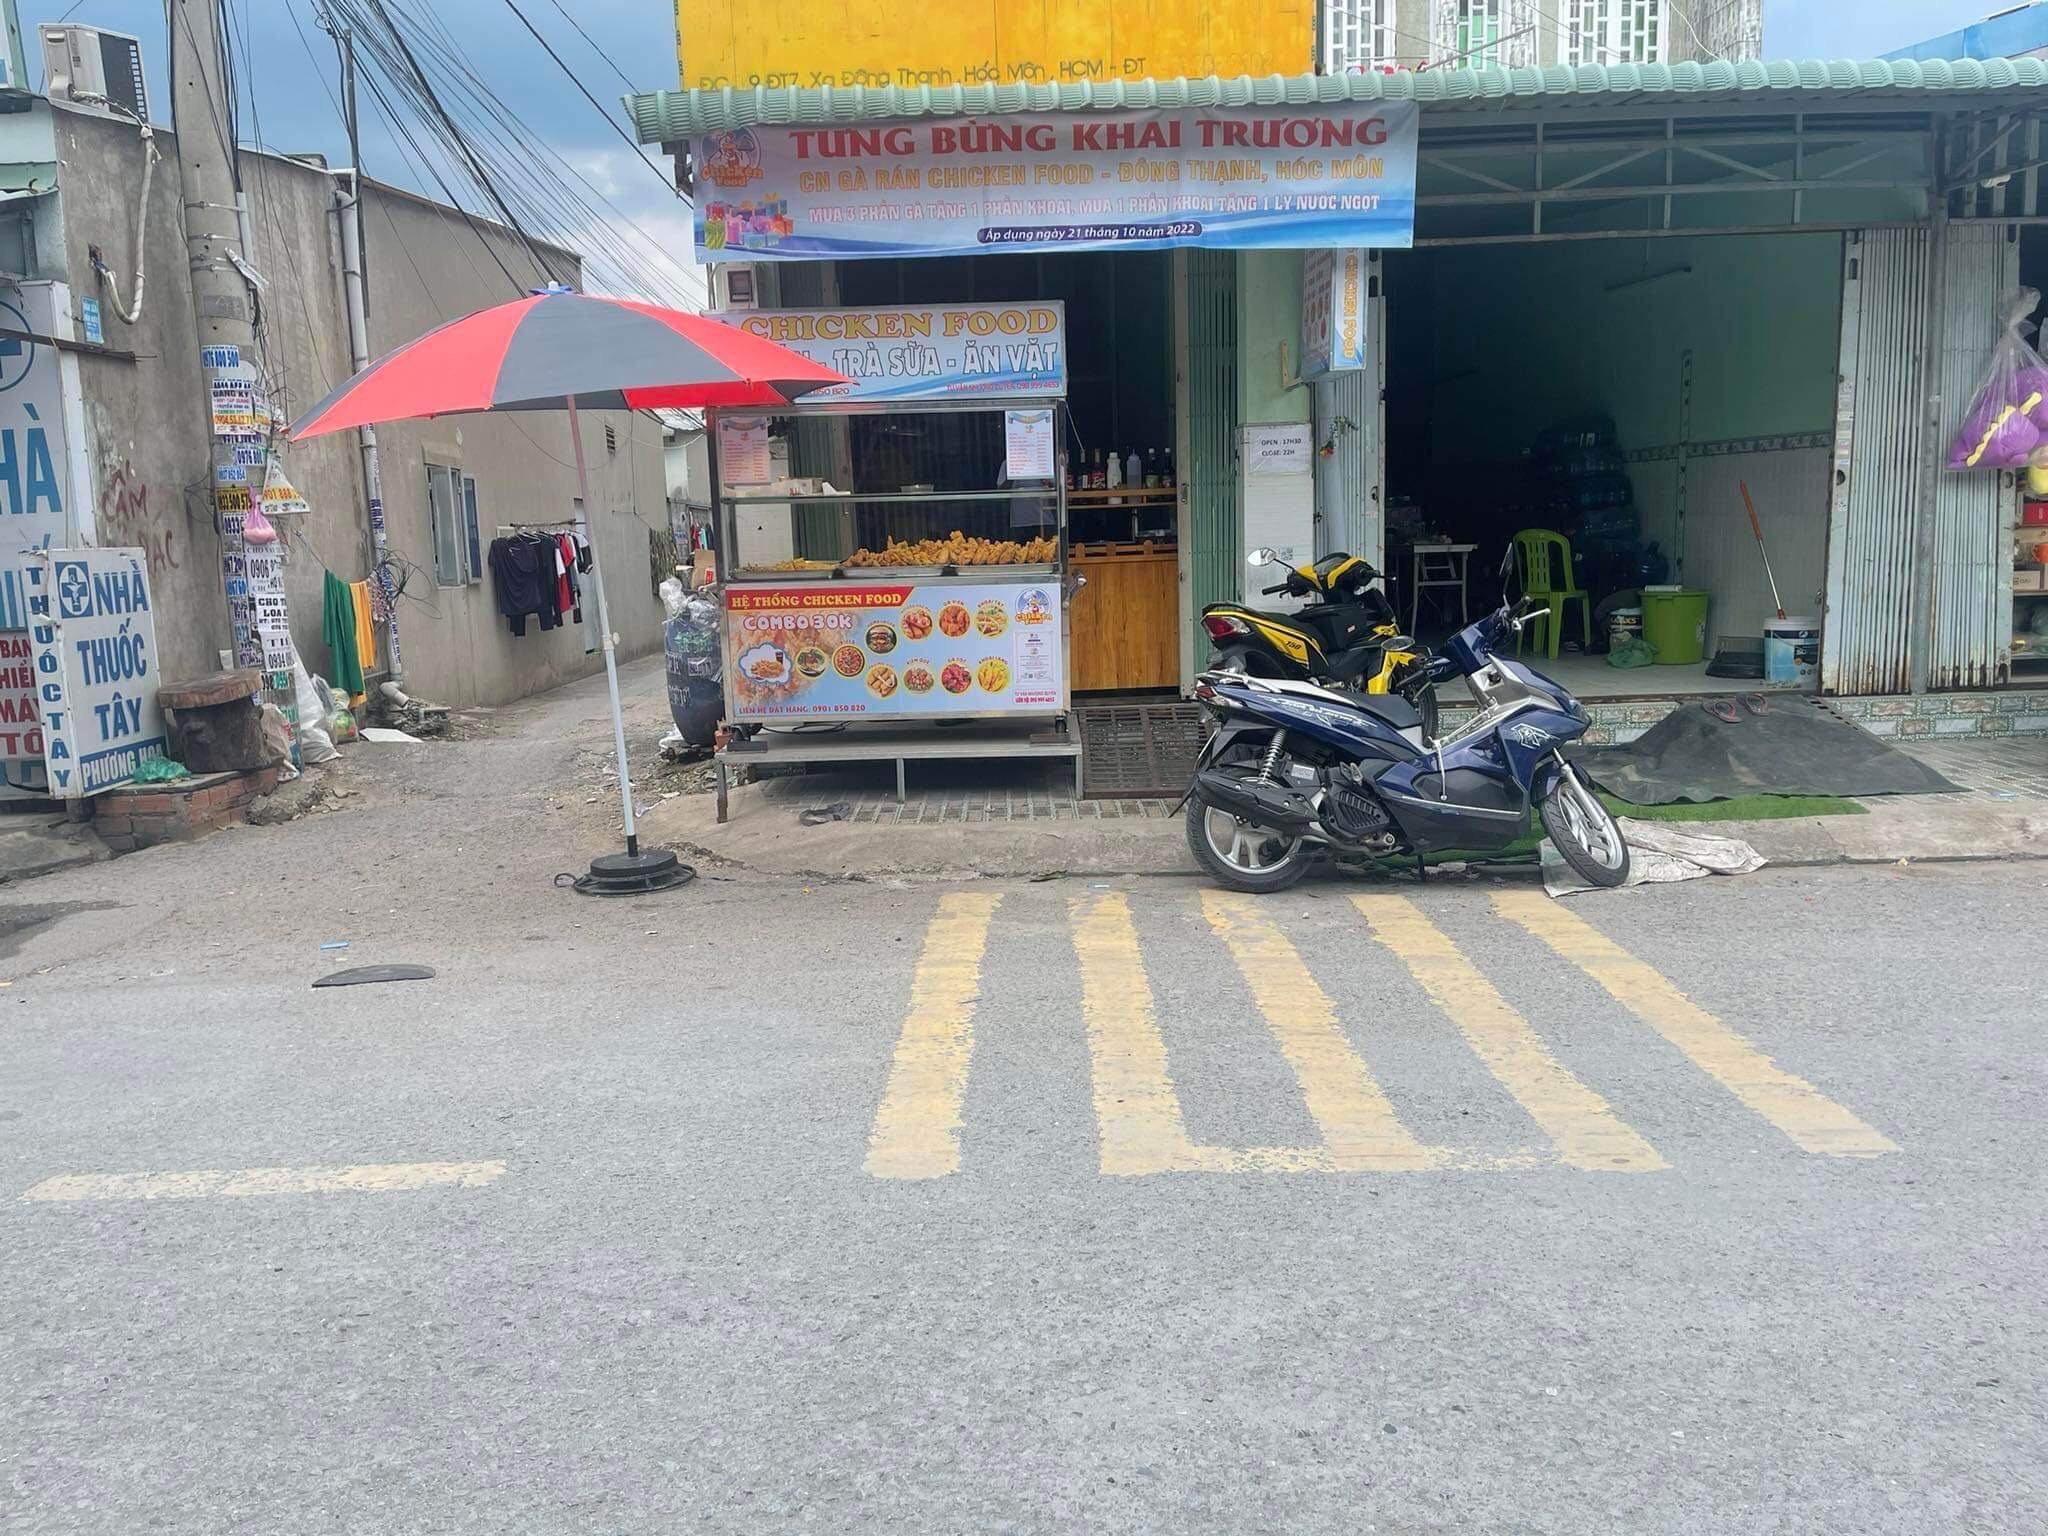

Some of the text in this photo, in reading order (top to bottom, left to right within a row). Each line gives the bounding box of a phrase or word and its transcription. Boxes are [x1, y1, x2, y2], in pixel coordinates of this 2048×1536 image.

[963, 60, 1000, 83] Hóc
[1059, 60, 1104, 79] HCM
[1122, 58, 1147, 75] ĐT
[931, 117, 1057, 154] BỪNG
[1072, 121, 1182, 152] KHAI
[1195, 117, 1388, 149] TRƯƠNG
[800, 170, 831, 193] CN
[838, 165, 869, 193] GÀ
[875, 164, 921, 190] RÁN
[927, 164, 1026, 189] CHICKEN
[1034, 163, 1095, 185] FOOD
[1117, 157, 1181, 183] ĐÔNG
[1276, 156, 1324, 181] HÓC
[1331, 153, 1385, 179] MÔN
[809, 206, 843, 224] MUA
[847, 206, 855, 223] 3
[904, 202, 924, 220] GÀ
[971, 203, 979, 217] 1
[1079, 198, 1113, 214] MUA
[1263, 196, 1269, 211] 1
[1274, 195, 1293, 211] LY
[1340, 195, 1381, 213] NGỌT
[985, 224, 1195, 243] Áp dụng ngày 21 tháng 10 năm 2022
[740, 309, 1058, 341] CHICKEN FOOD
[832, 342, 885, 377] TRÀ
[888, 340, 942, 377] SỮA
[962, 340, 1001, 375] ĂN
[1006, 338, 1058, 380] VẶT
[92, 560, 149, 616] NHÀ
[258, 598, 279, 607] CHO
[732, 592, 902, 610] HỆ THỐNG CHICKEN FOOD
[743, 613, 852, 631] COMBO 30K
[77, 617, 147, 687] THUỐC
[94, 691, 143, 741] TÂY
